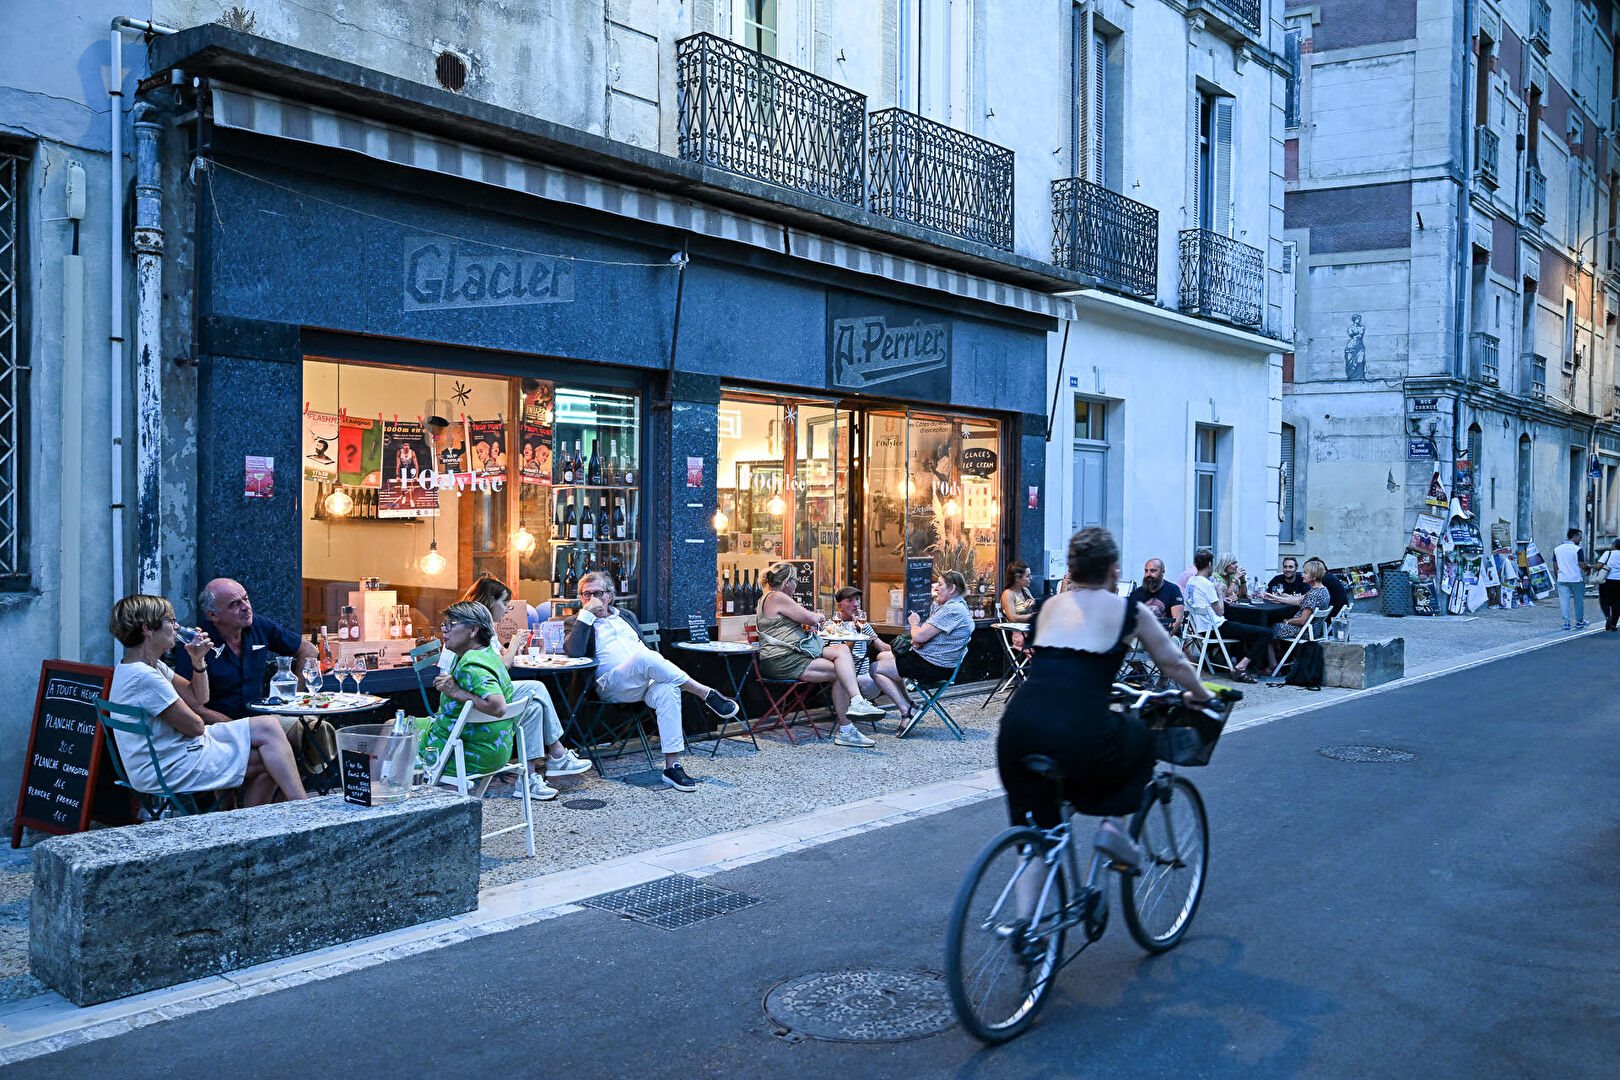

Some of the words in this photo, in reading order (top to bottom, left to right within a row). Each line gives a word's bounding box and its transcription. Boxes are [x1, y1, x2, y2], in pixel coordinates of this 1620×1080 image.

[405, 242, 572, 304] Glacier
[964, 451, 991, 459] GLACES
[56, 685, 78, 697] TOUTE
[45, 713, 76, 731] PLANCHE
[33, 753, 59, 770] PLANCHE
[28, 786, 51, 800] PLANCHE
[56, 794, 80, 808] FROMAGE
